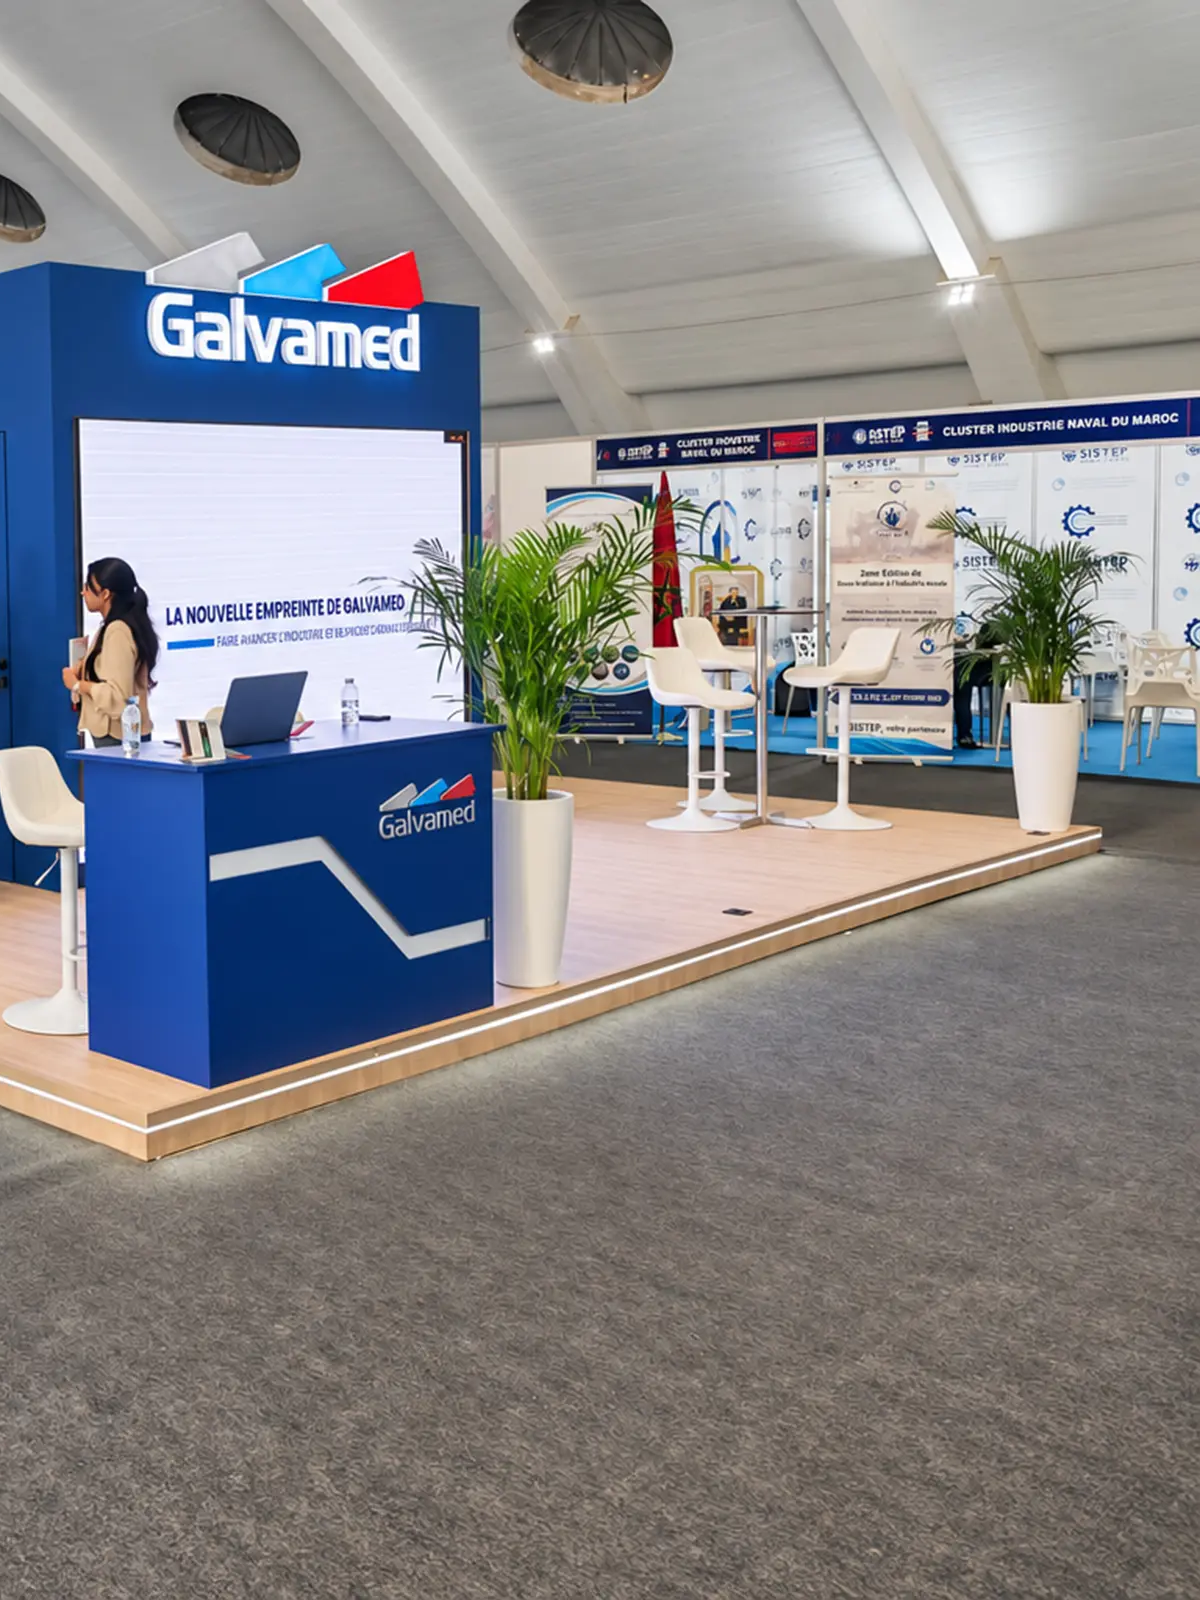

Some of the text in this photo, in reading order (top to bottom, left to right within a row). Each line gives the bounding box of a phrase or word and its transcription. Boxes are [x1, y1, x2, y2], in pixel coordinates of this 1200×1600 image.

[147, 292, 420, 371] Galvamed
[943, 413, 1178, 436] CLUSTER INDUSTRIE NAVAL DU MAROC
[1080, 447, 1128, 458] SISTEP
[166, 607, 183, 625] LA
[186, 602, 253, 624] NOUVELLE
[256, 598, 324, 620] EMPREINTE
[327, 597, 341, 615] DE
[379, 800, 475, 839] Galvamed
